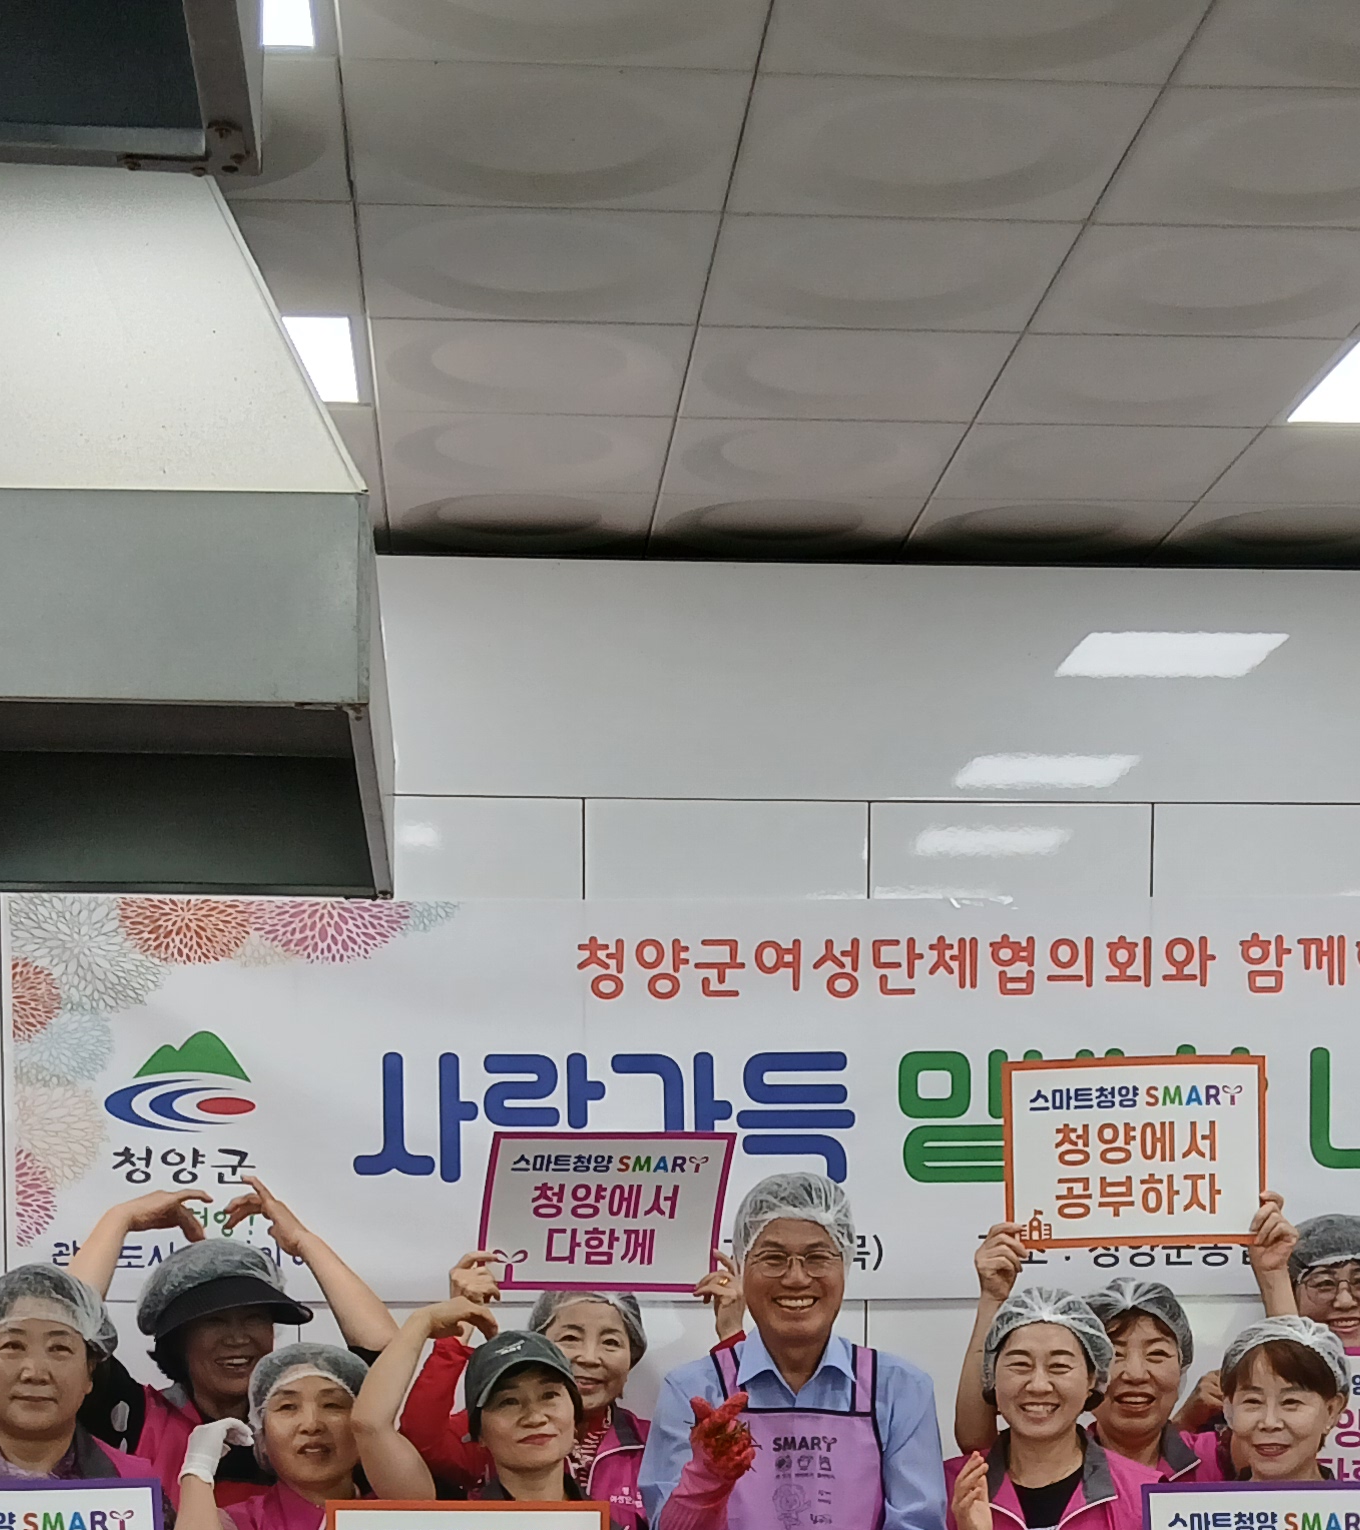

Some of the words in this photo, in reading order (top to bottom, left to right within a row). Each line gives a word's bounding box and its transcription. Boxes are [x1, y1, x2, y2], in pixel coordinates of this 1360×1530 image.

[576, 933, 1216, 1000] 청양군여성단체협의회와
[1028, 1085, 1140, 1113] 스마트청양
[510, 1153, 613, 1175] 스마트청양
[1054, 1120, 1219, 1168] 청양에서
[112, 1146, 257, 1186] 청양군
[531, 1182, 679, 1222] 청양에서
[1054, 1172, 1222, 1220] 공부하자
[544, 1227, 656, 1267] 다함께
